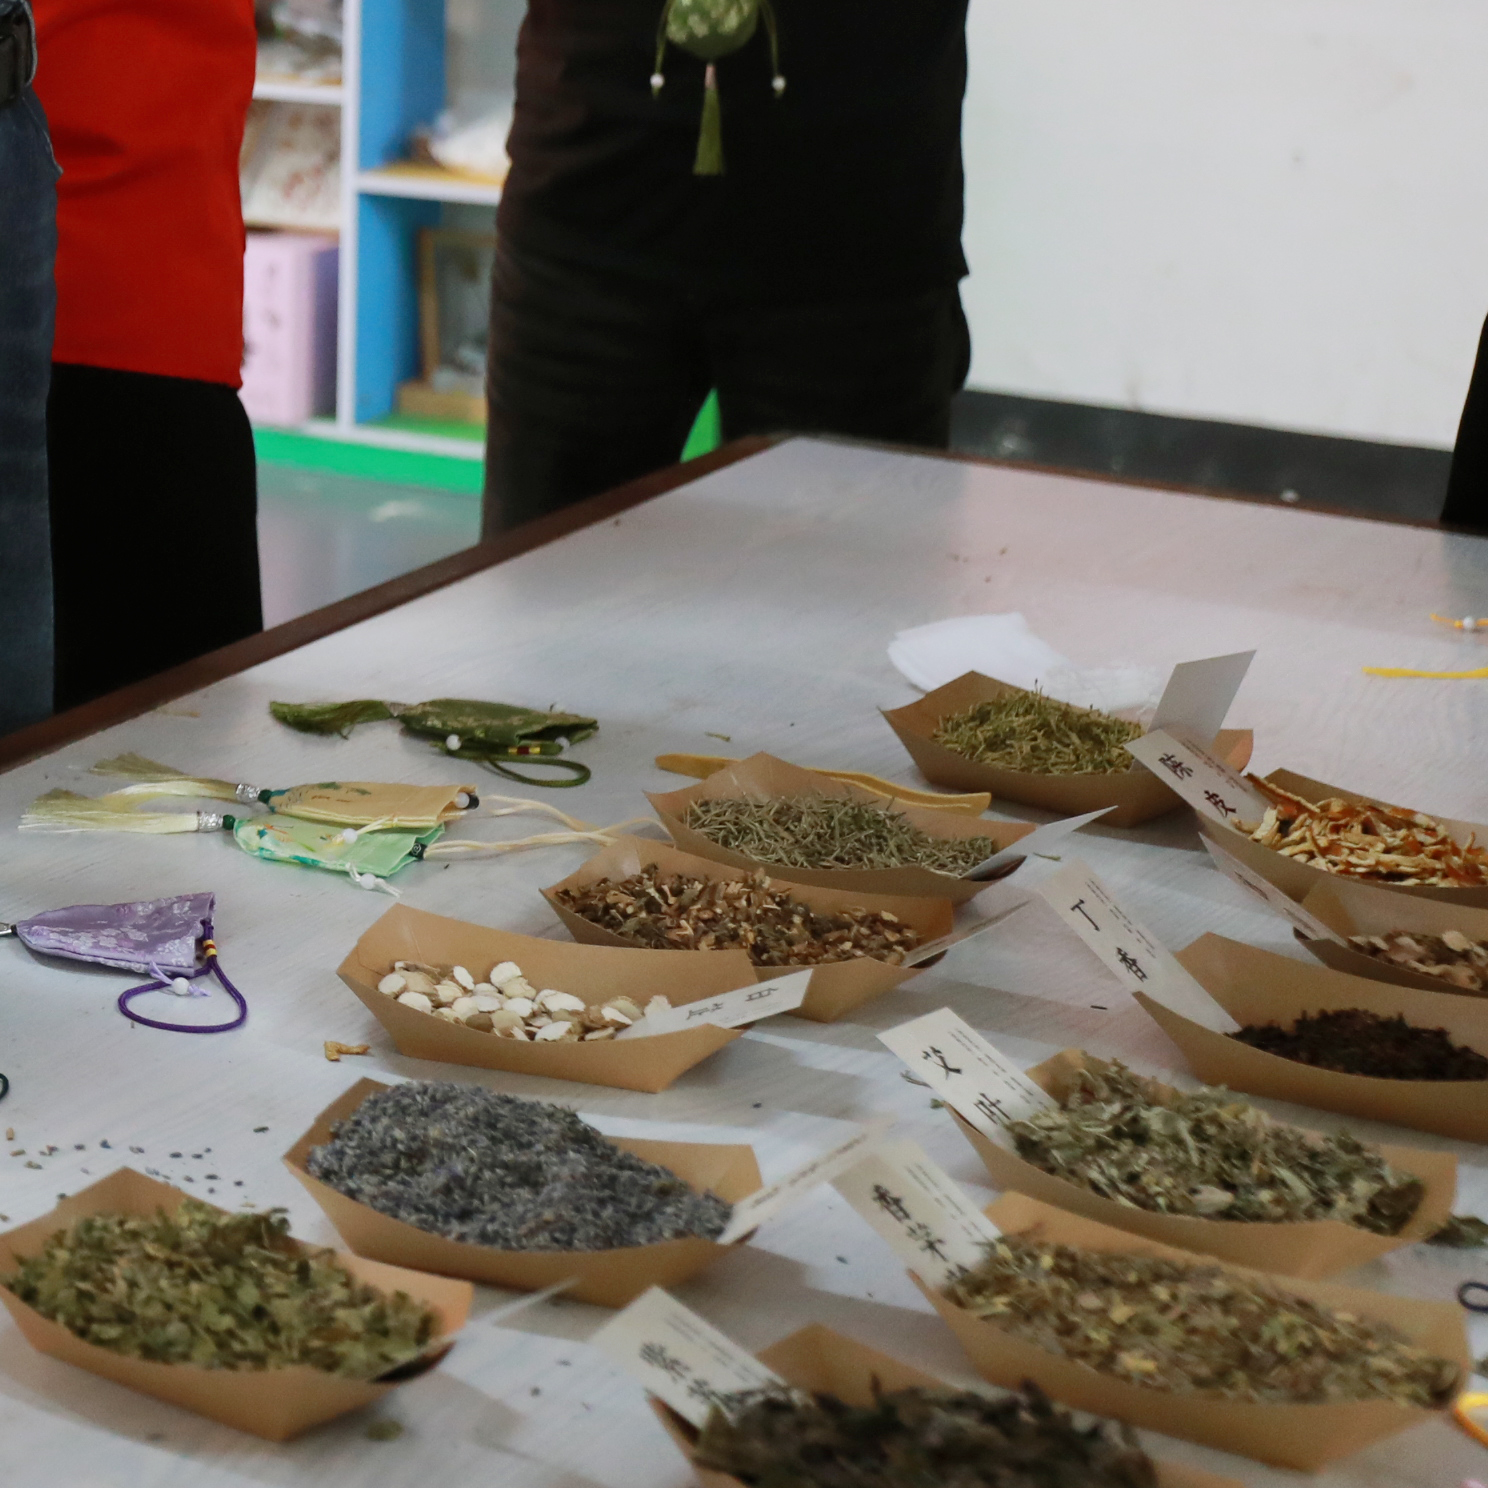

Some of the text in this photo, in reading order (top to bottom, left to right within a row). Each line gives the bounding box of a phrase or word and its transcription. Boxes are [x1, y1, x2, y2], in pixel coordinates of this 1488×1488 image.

[1157, 752, 1237, 818] 陈皮
[1070, 898, 1149, 983] 丁香
[921, 1045, 1013, 1127] 艾叶
